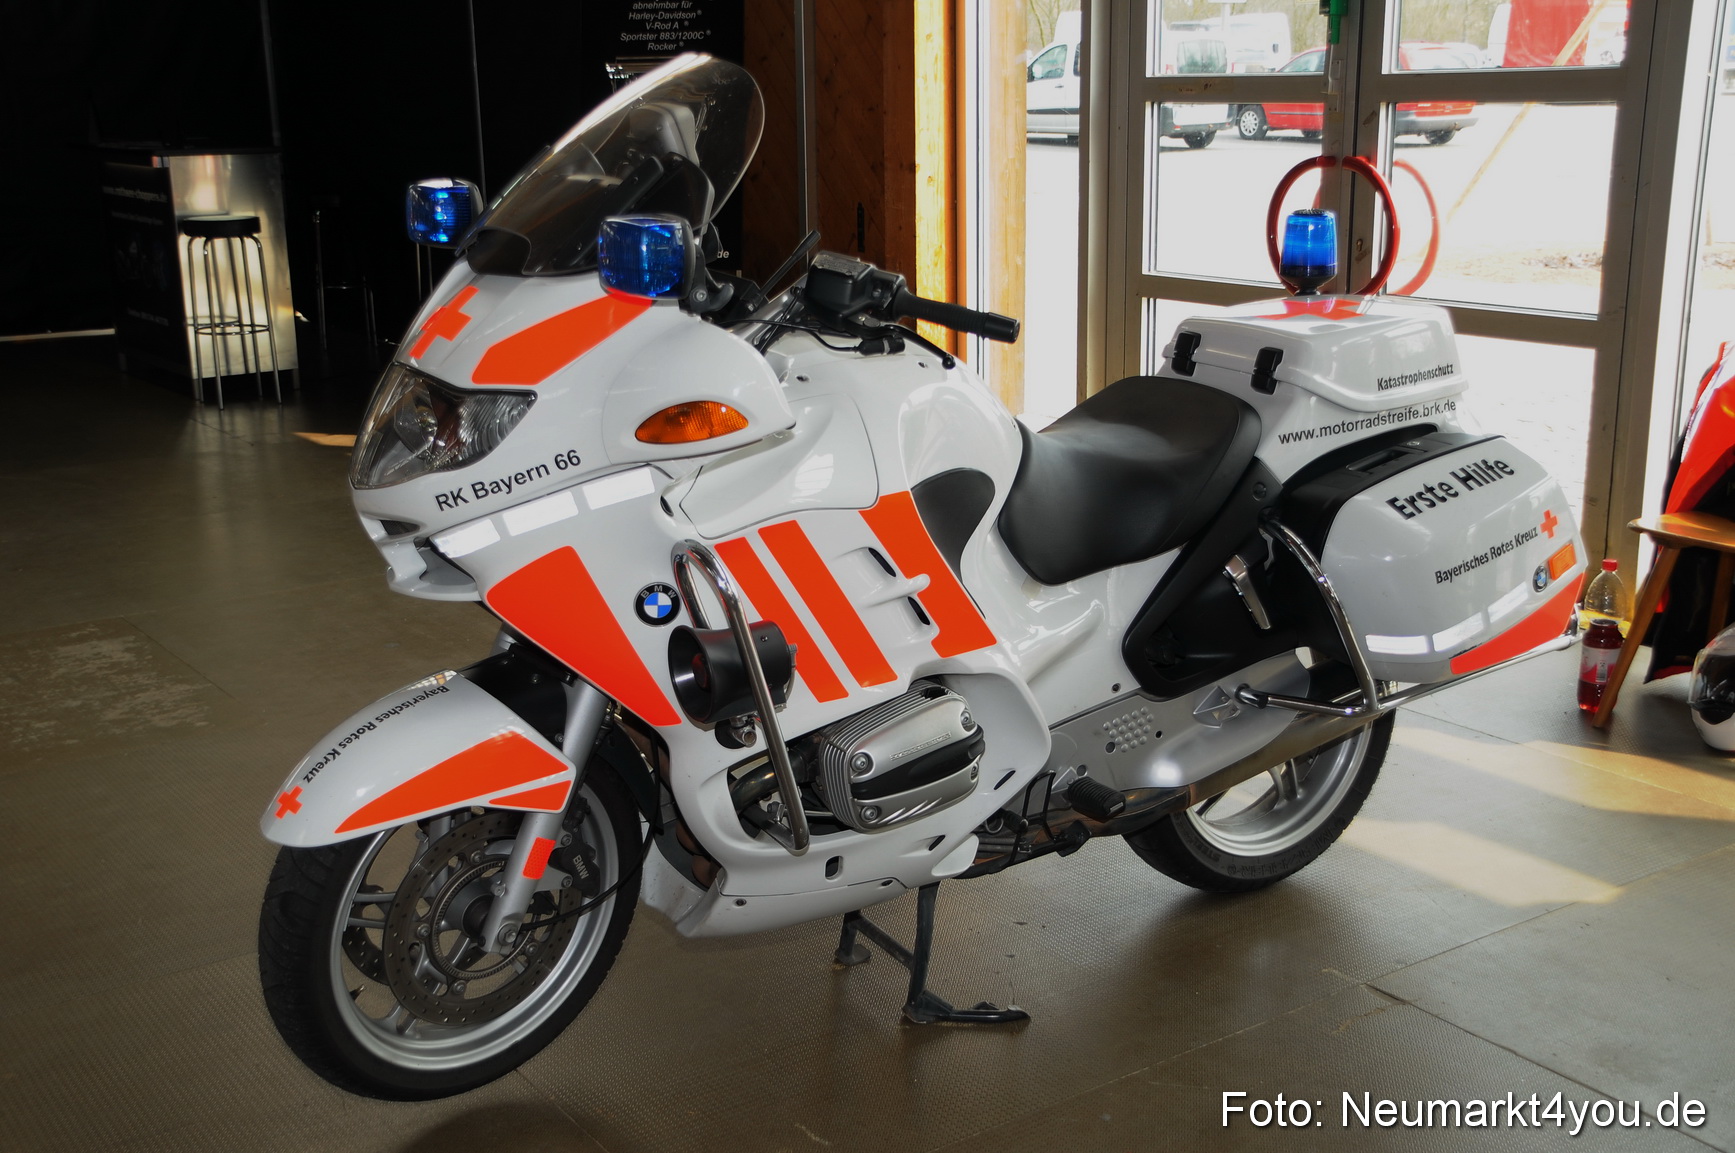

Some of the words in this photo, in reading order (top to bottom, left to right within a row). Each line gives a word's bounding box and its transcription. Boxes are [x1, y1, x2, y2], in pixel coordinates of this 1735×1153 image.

[633, 1, 679, 10] abnehmbar
[681, 1, 692, 9] für
[620, 33, 658, 42] Sportster
[659, 31, 705, 40] 883/1200C
[645, 22, 671, 30] V-Rod
[647, 42, 677, 50] Rocker
[1377, 363, 1454, 391] Katastrophenschutz
[1278, 399, 1456, 445] www.motorradstreife.brk.de
[434, 488, 469, 512] RK
[471, 463, 550, 500] Bayern
[554, 449, 582, 471] 66
[1386, 483, 1459, 520] Erste
[1449, 459, 1515, 491] Hilfe
[1434, 552, 1489, 584] Bayerisches
[1490, 539, 1515, 560] Rotes
[1514, 526, 1539, 547] Kreuz
[640, 585, 677, 599] BMW
[375, 685, 450, 723] Bayerisches
[339, 721, 378, 749] Rotes
[302, 748, 342, 784] Kreuz
[572, 855, 590, 880] BMW
